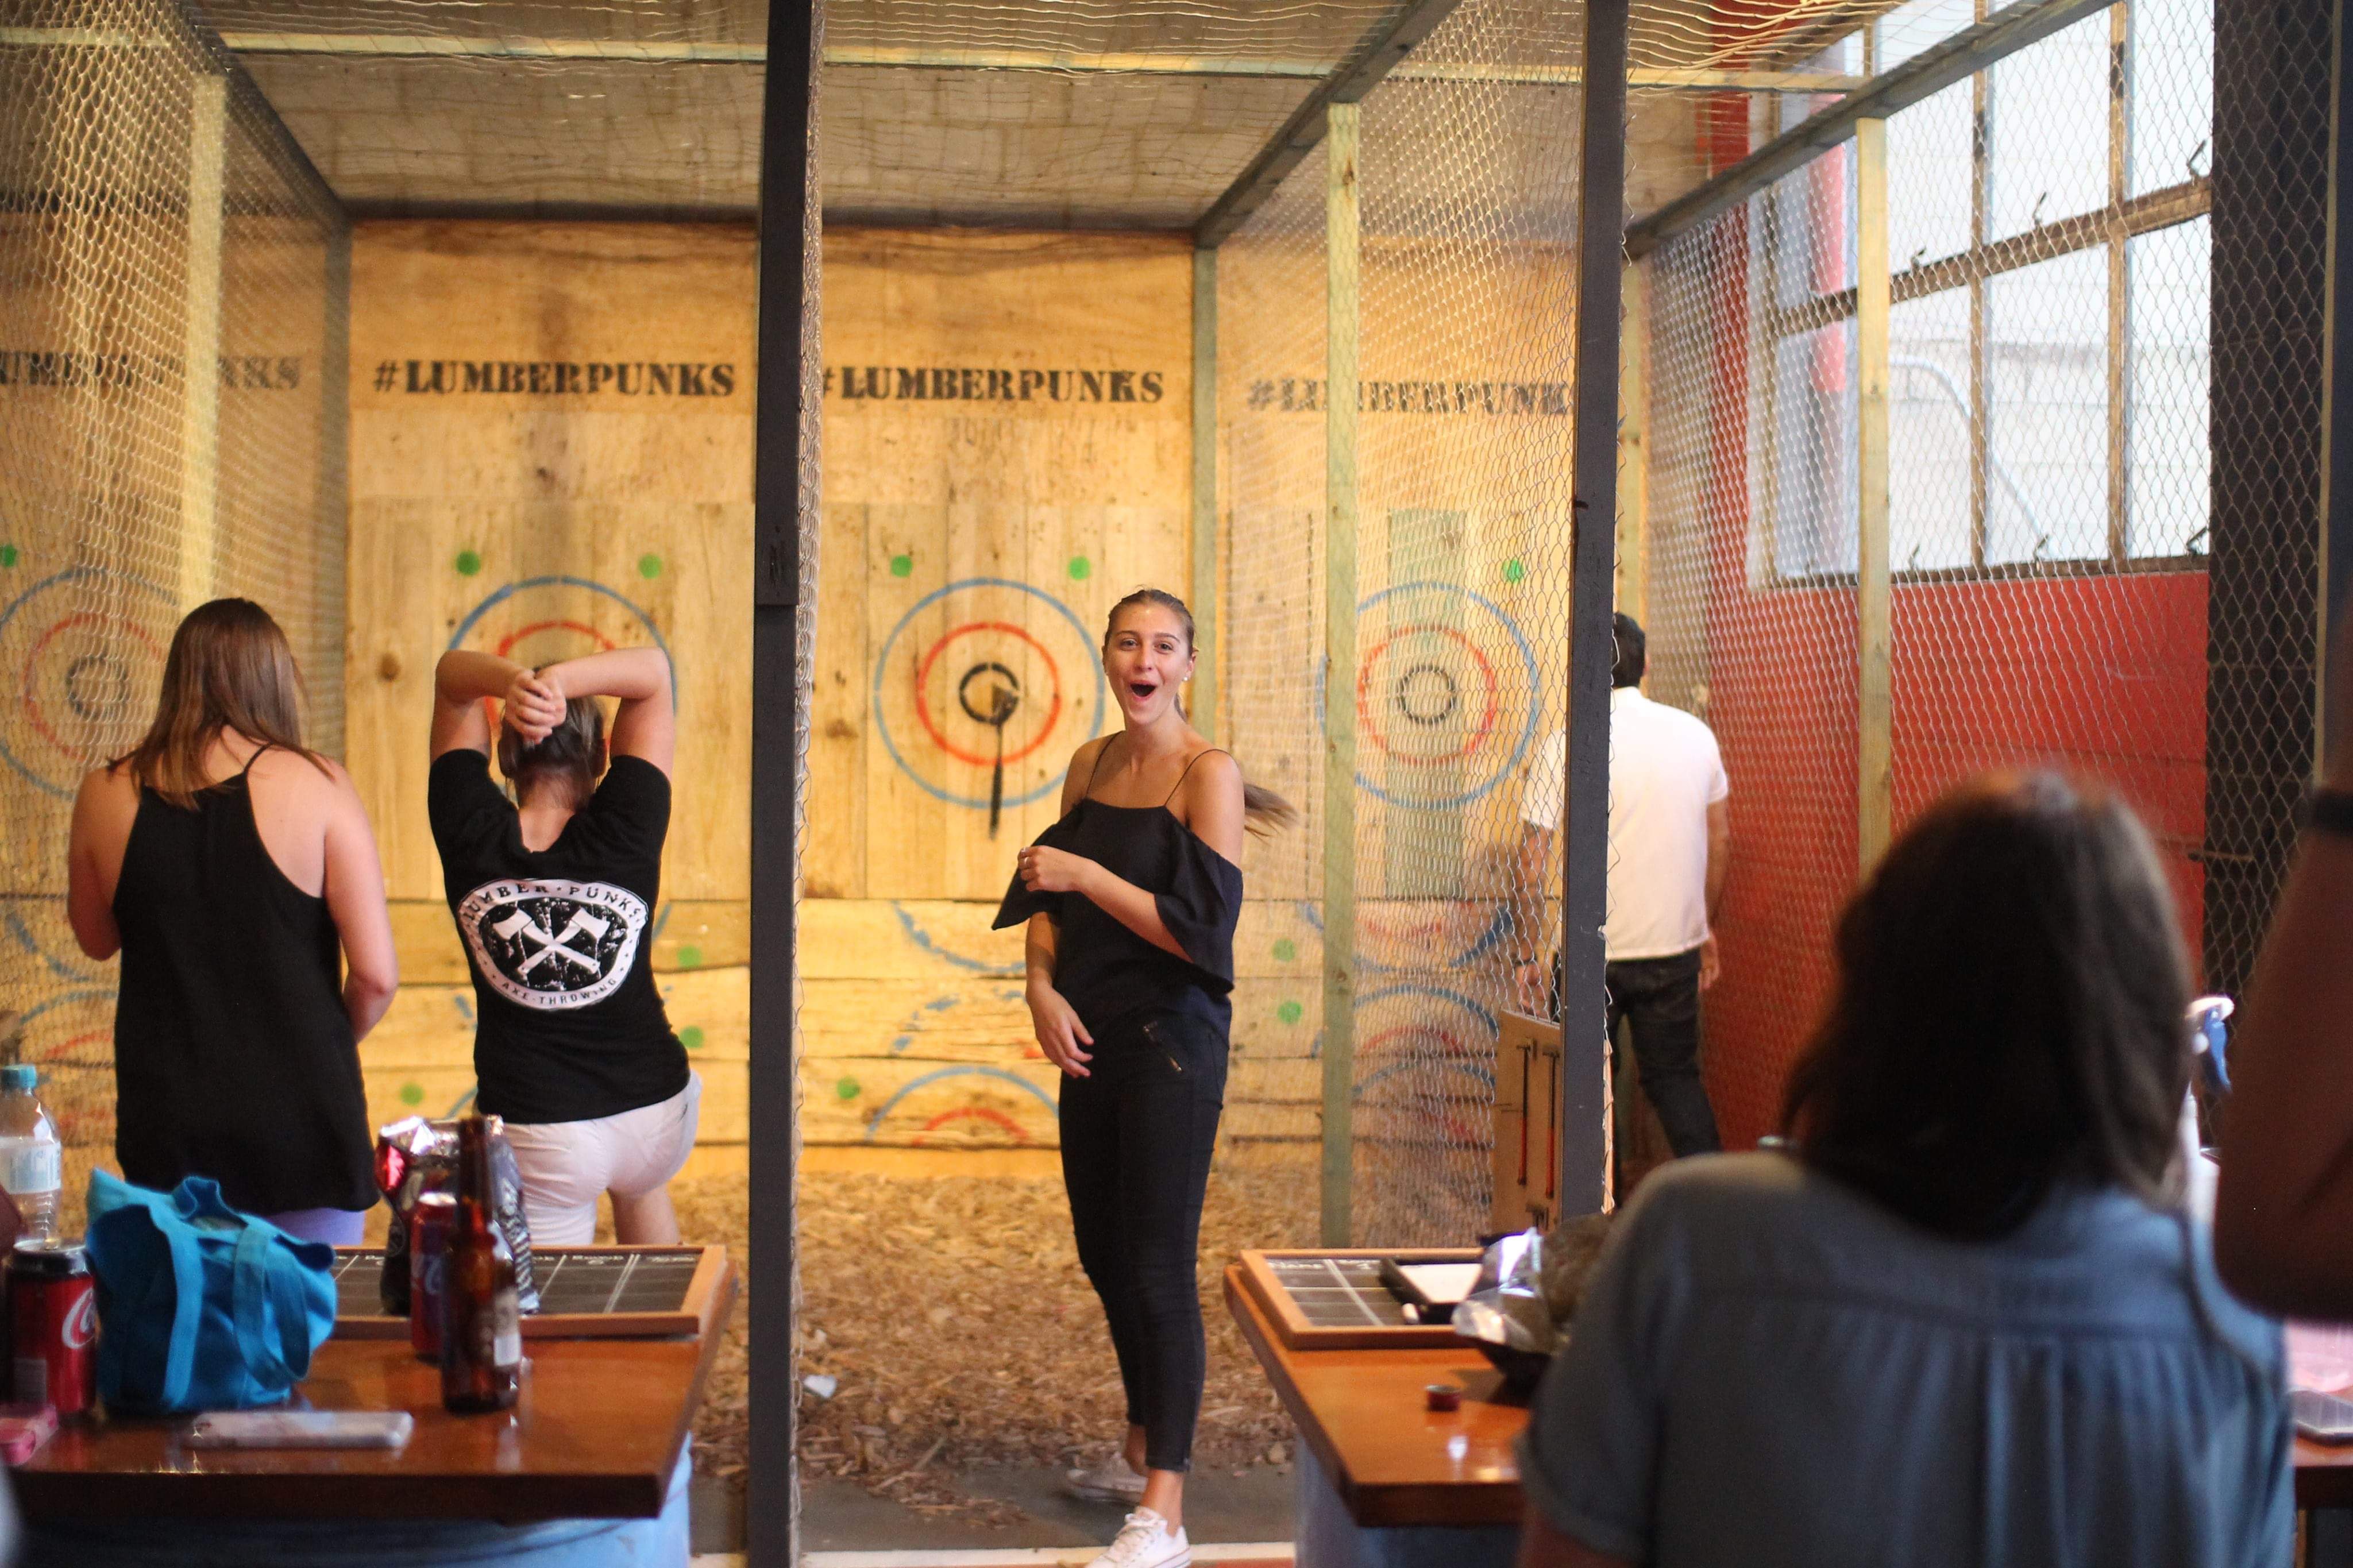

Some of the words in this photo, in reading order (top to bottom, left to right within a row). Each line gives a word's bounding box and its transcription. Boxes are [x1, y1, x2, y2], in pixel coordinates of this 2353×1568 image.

[372, 360, 735, 397] #LUMBERPUNKS
[462, 883, 550, 920] LUMBER
[569, 886, 641, 918] PUNKS
